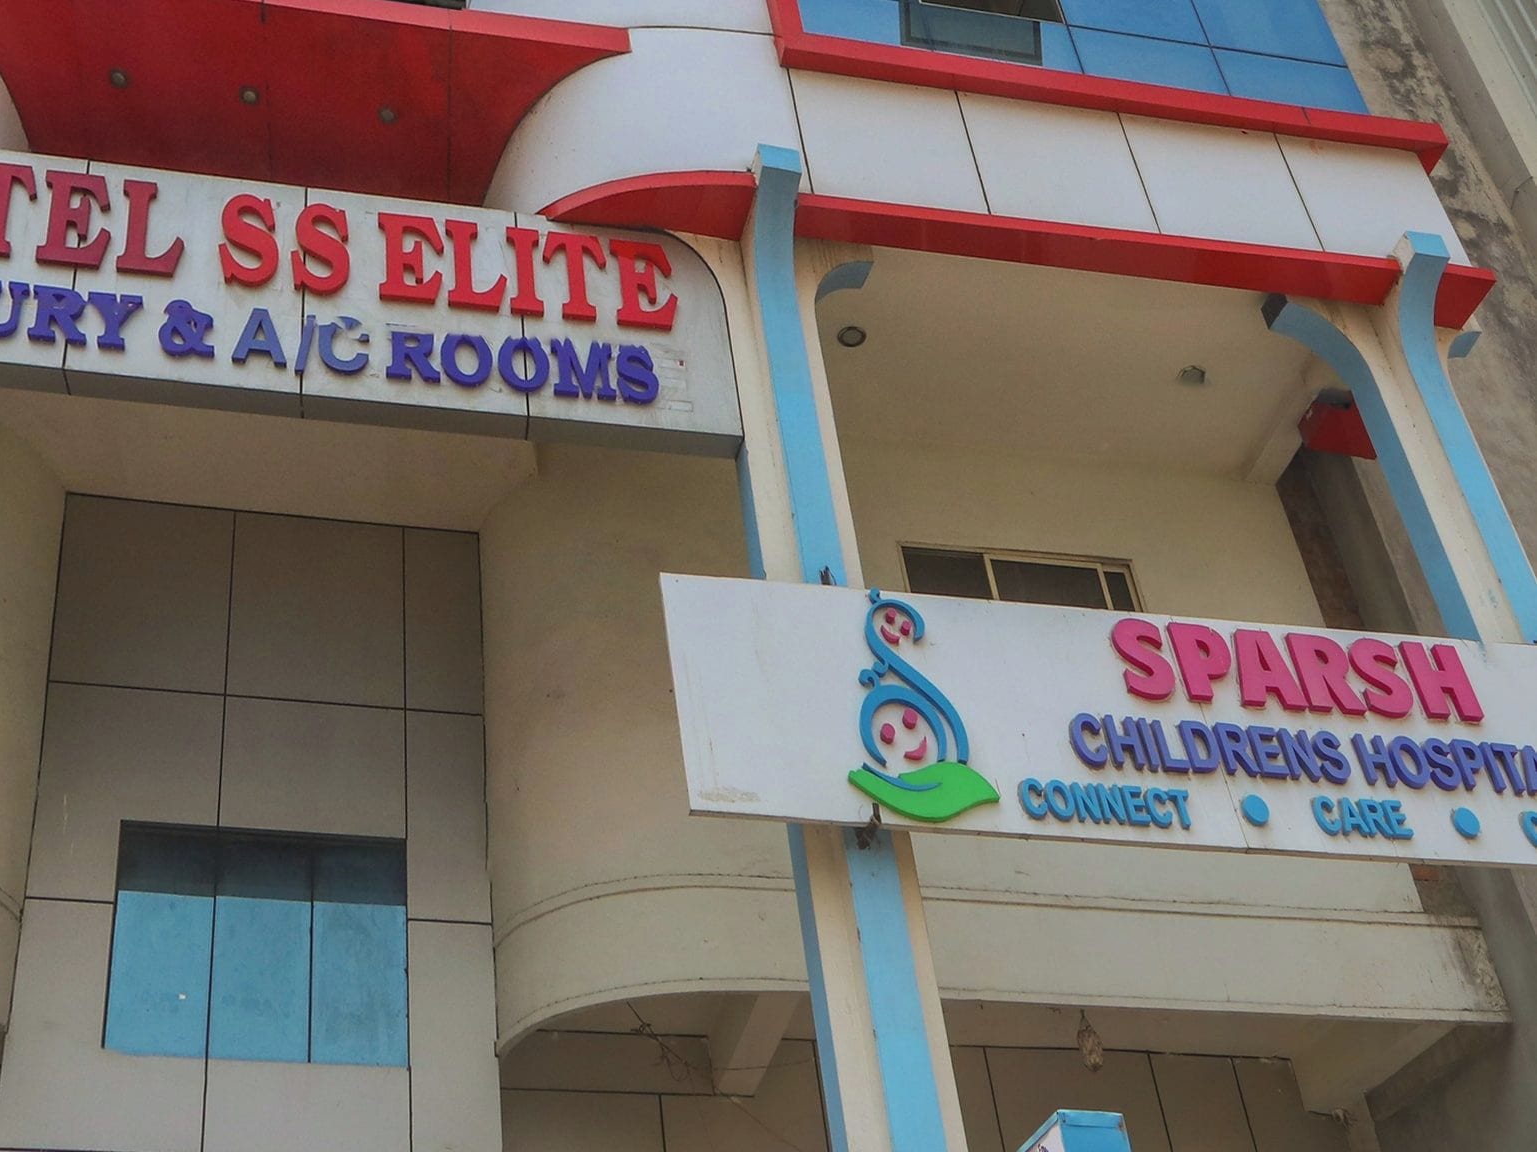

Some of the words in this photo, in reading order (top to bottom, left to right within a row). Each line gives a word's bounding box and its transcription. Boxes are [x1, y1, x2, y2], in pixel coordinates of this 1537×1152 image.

[218, 193, 350, 296] SS
[377, 212, 679, 331] ELITE
[158, 299, 215, 359] &
[231, 307, 370, 376] A/C
[385, 330, 660, 405] ROOMS
[1111, 618, 1485, 724] SPARSH
[1070, 712, 1352, 786] CHILDRENS
[1018, 777, 1190, 830] CONNECT
[1313, 795, 1415, 841] CARE
